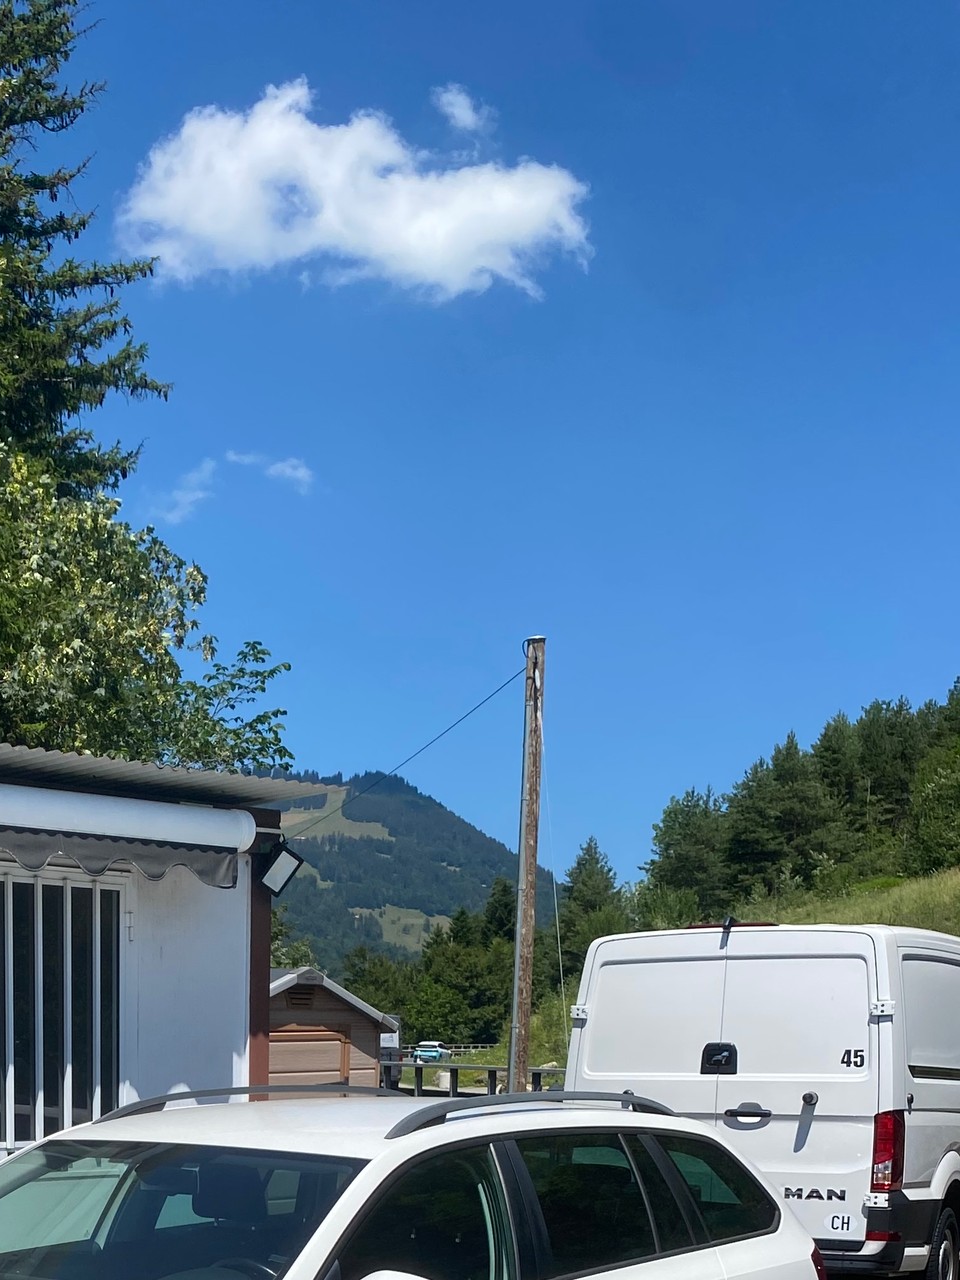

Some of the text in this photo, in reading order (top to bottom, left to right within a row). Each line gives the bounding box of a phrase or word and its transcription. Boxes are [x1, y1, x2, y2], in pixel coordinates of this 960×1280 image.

[840, 1048, 866, 1068] 45
[783, 1187, 847, 1202] MAN
[831, 1214, 851, 1232] CH
